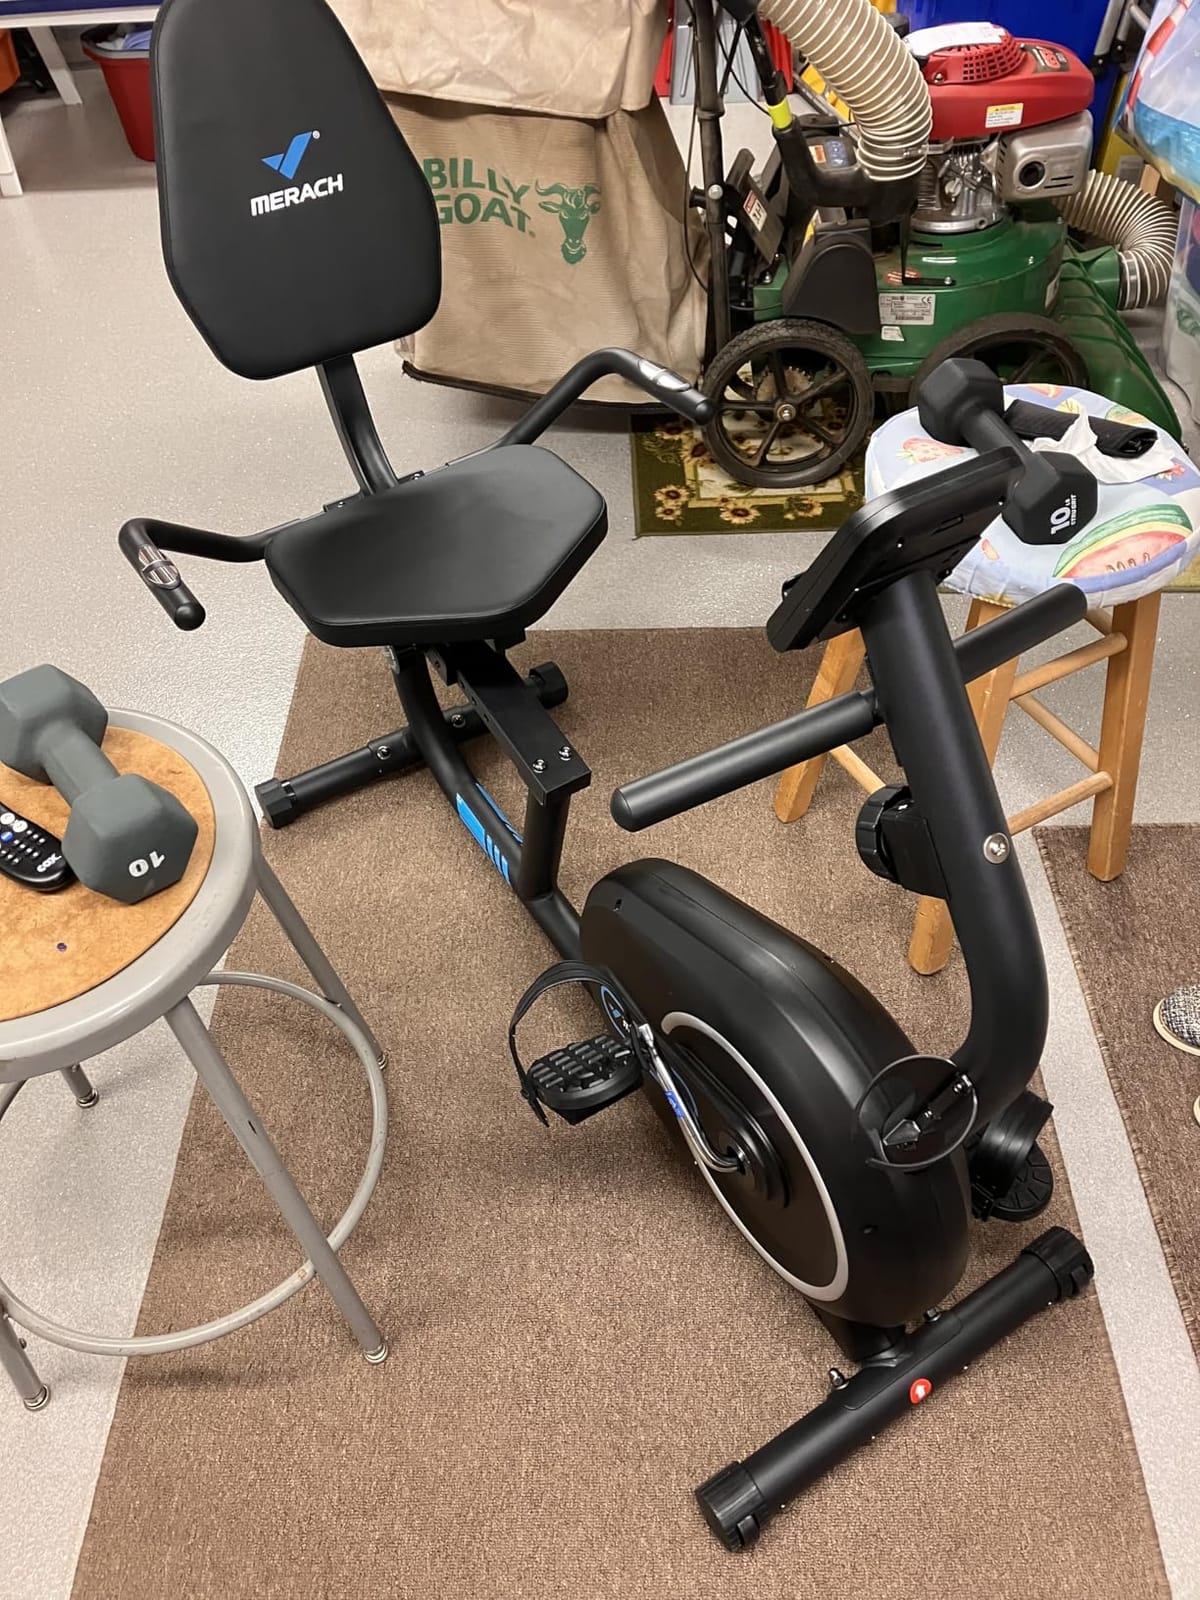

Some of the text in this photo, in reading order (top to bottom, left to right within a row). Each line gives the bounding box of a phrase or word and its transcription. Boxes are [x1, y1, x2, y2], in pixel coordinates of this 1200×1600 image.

[250, 173, 344, 216] MERACH
[423, 157, 530, 204] BILLY
[434, 192, 532, 233] GOAT
[1050, 506, 1071, 535] 10
[128, 850, 165, 877] 10
